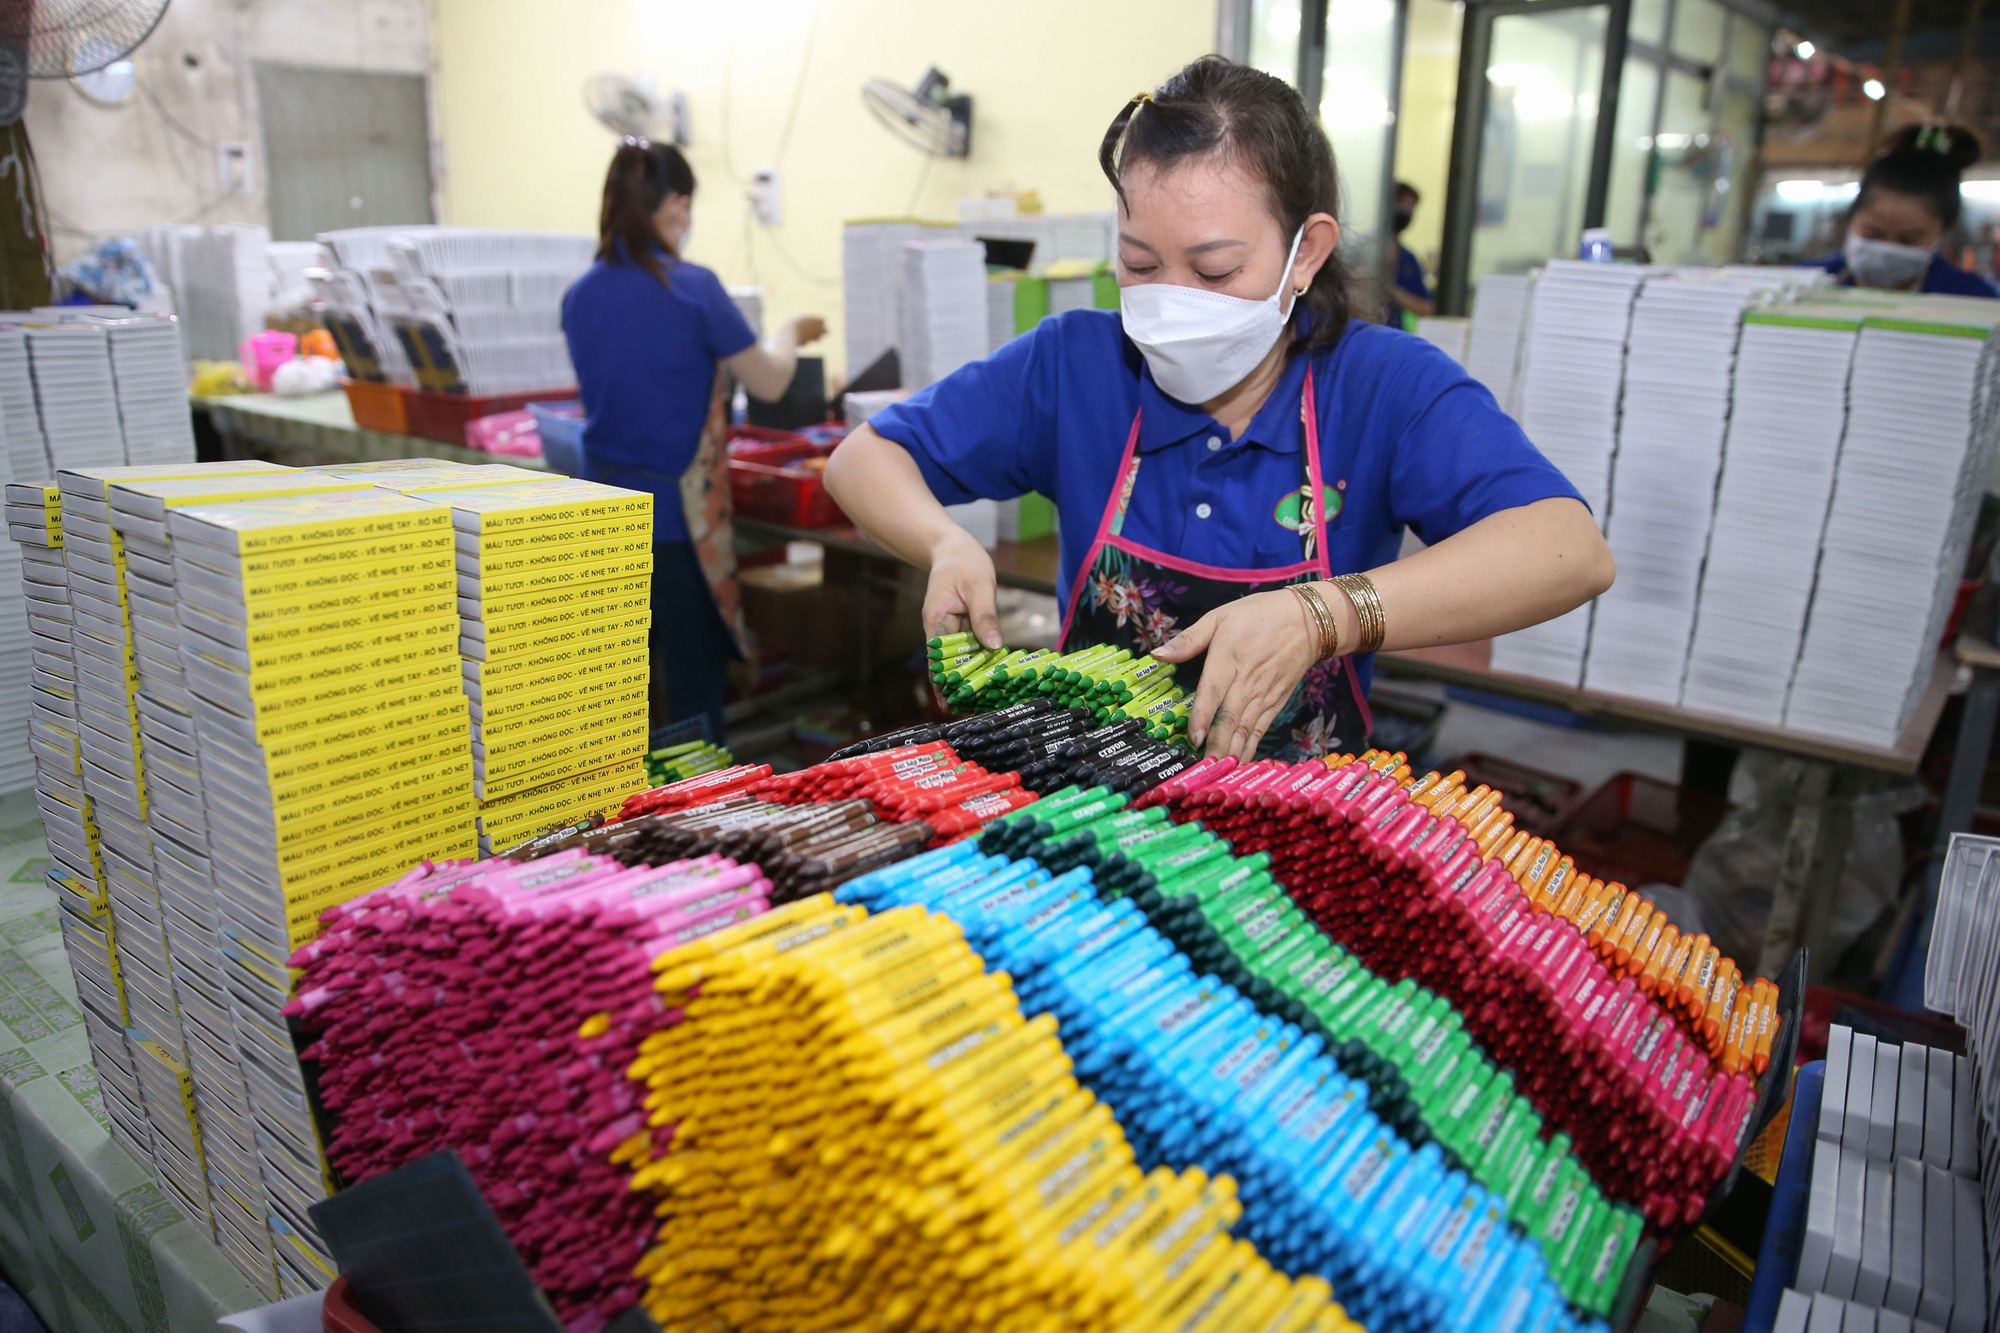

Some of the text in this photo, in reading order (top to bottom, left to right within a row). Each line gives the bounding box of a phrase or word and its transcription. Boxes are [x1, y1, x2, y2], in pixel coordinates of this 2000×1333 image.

[1098, 741, 1126, 758] crayon
[1158, 763, 1184, 779] crayon
[603, 785, 614, 794] TAY
[1430, 780, 1450, 795] crayon
[1712, 977, 1724, 1002] crayon
[1746, 1002, 1758, 1034] crayon
[1759, 1005, 1770, 1034] crayon
